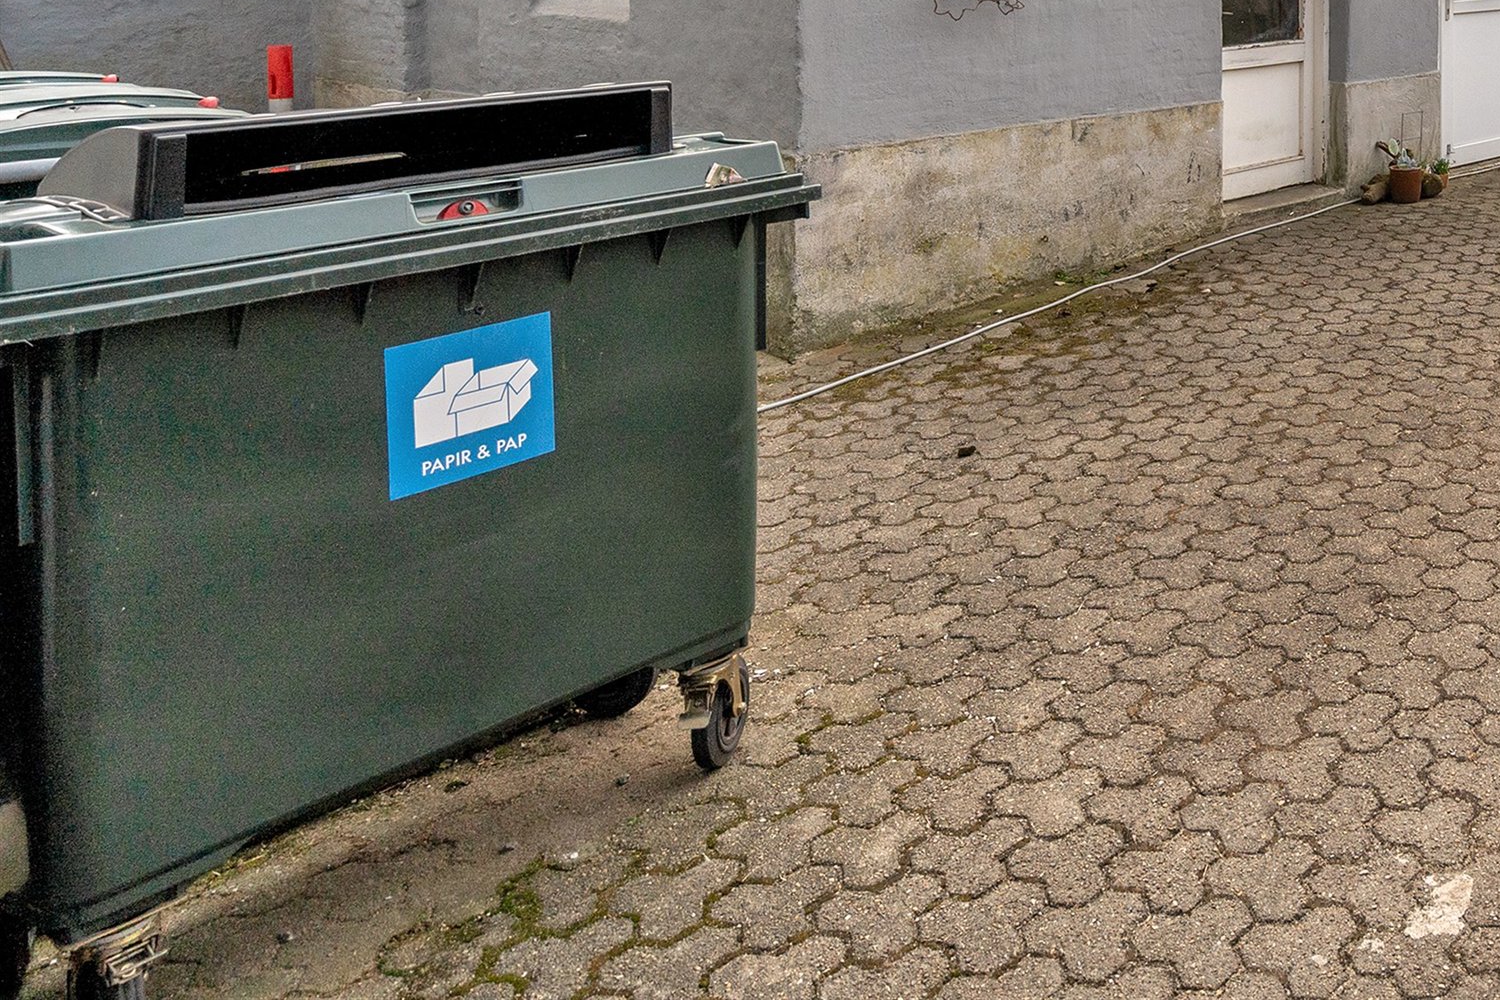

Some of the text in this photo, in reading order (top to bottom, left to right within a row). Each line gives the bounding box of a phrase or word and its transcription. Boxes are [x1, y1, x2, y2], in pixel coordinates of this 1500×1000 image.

[421, 432, 527, 477] PAPIR & PAP
